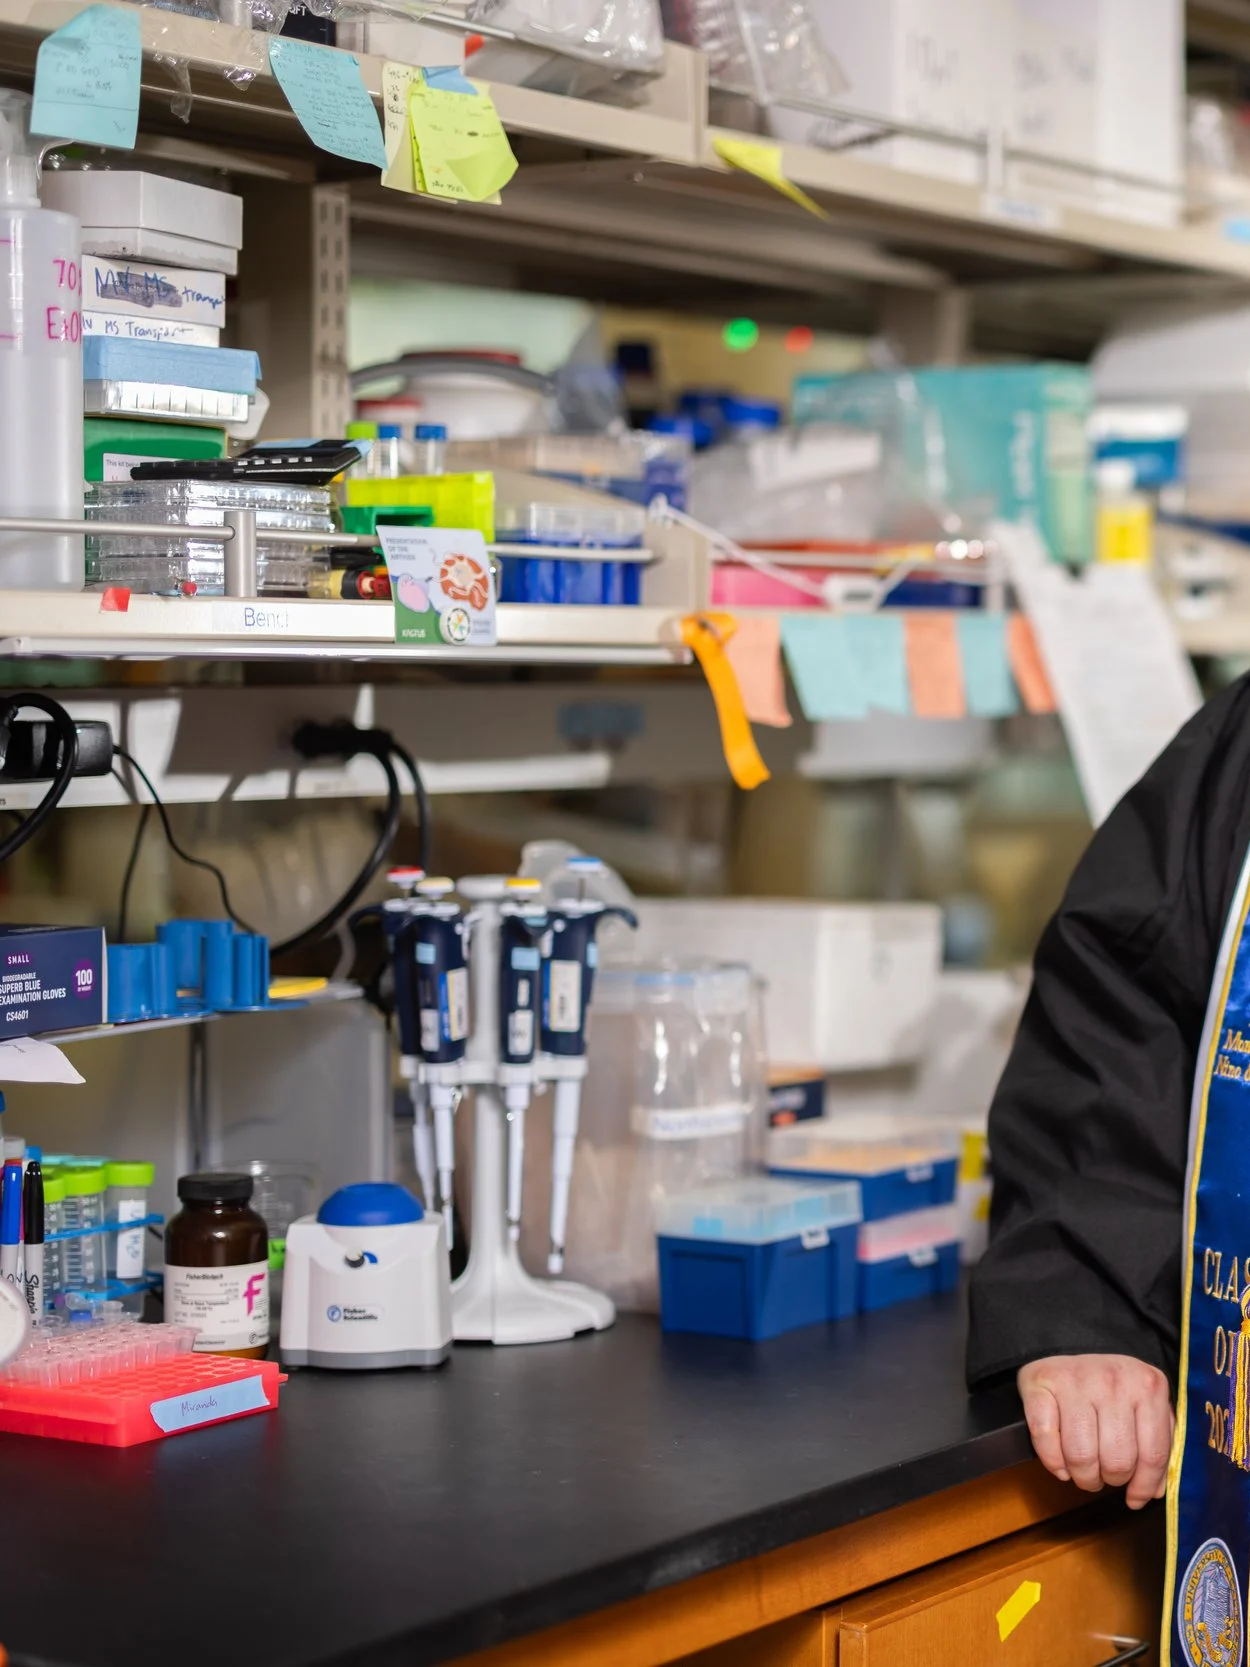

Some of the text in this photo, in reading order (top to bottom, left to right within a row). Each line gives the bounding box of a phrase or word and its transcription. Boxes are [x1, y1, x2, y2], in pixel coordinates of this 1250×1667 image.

[7, 953, 30, 965] SMALL
[2, 971, 37, 983] BIODEGRADABLE
[75, 968, 93, 986] 100
[24, 979, 41, 991] BLUE
[42, 987, 66, 1001] GLOVES
[6, 1009, 29, 1022] CS4601
[24, 1270, 40, 1315] Sharpie
[181, 1395, 218, 1416] Miranda
